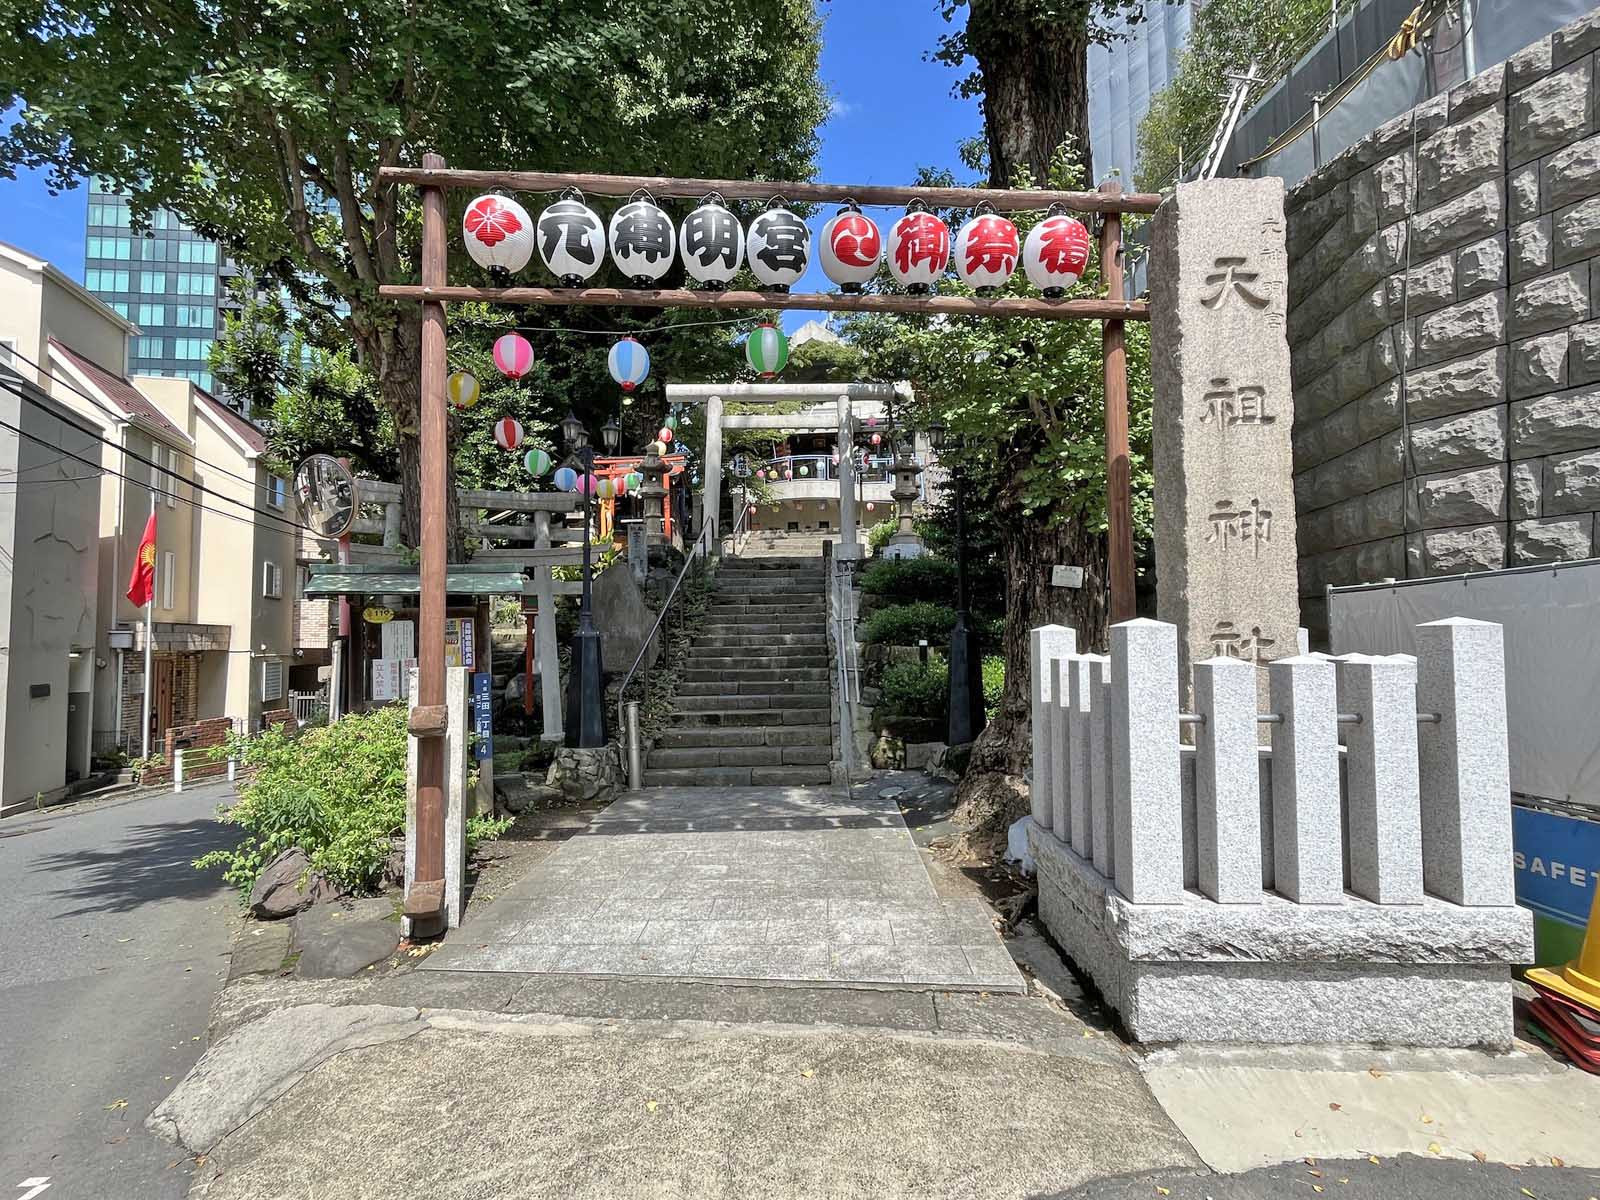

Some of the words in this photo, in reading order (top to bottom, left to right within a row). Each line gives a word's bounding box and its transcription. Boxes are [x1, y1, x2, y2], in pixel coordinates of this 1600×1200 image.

[538, 204, 809, 273] 元神明宮
[1200, 256, 1276, 667] 天祖神社
[481, 693, 490, 738] 三田一丁目
[480, 744, 487, 756] 4
